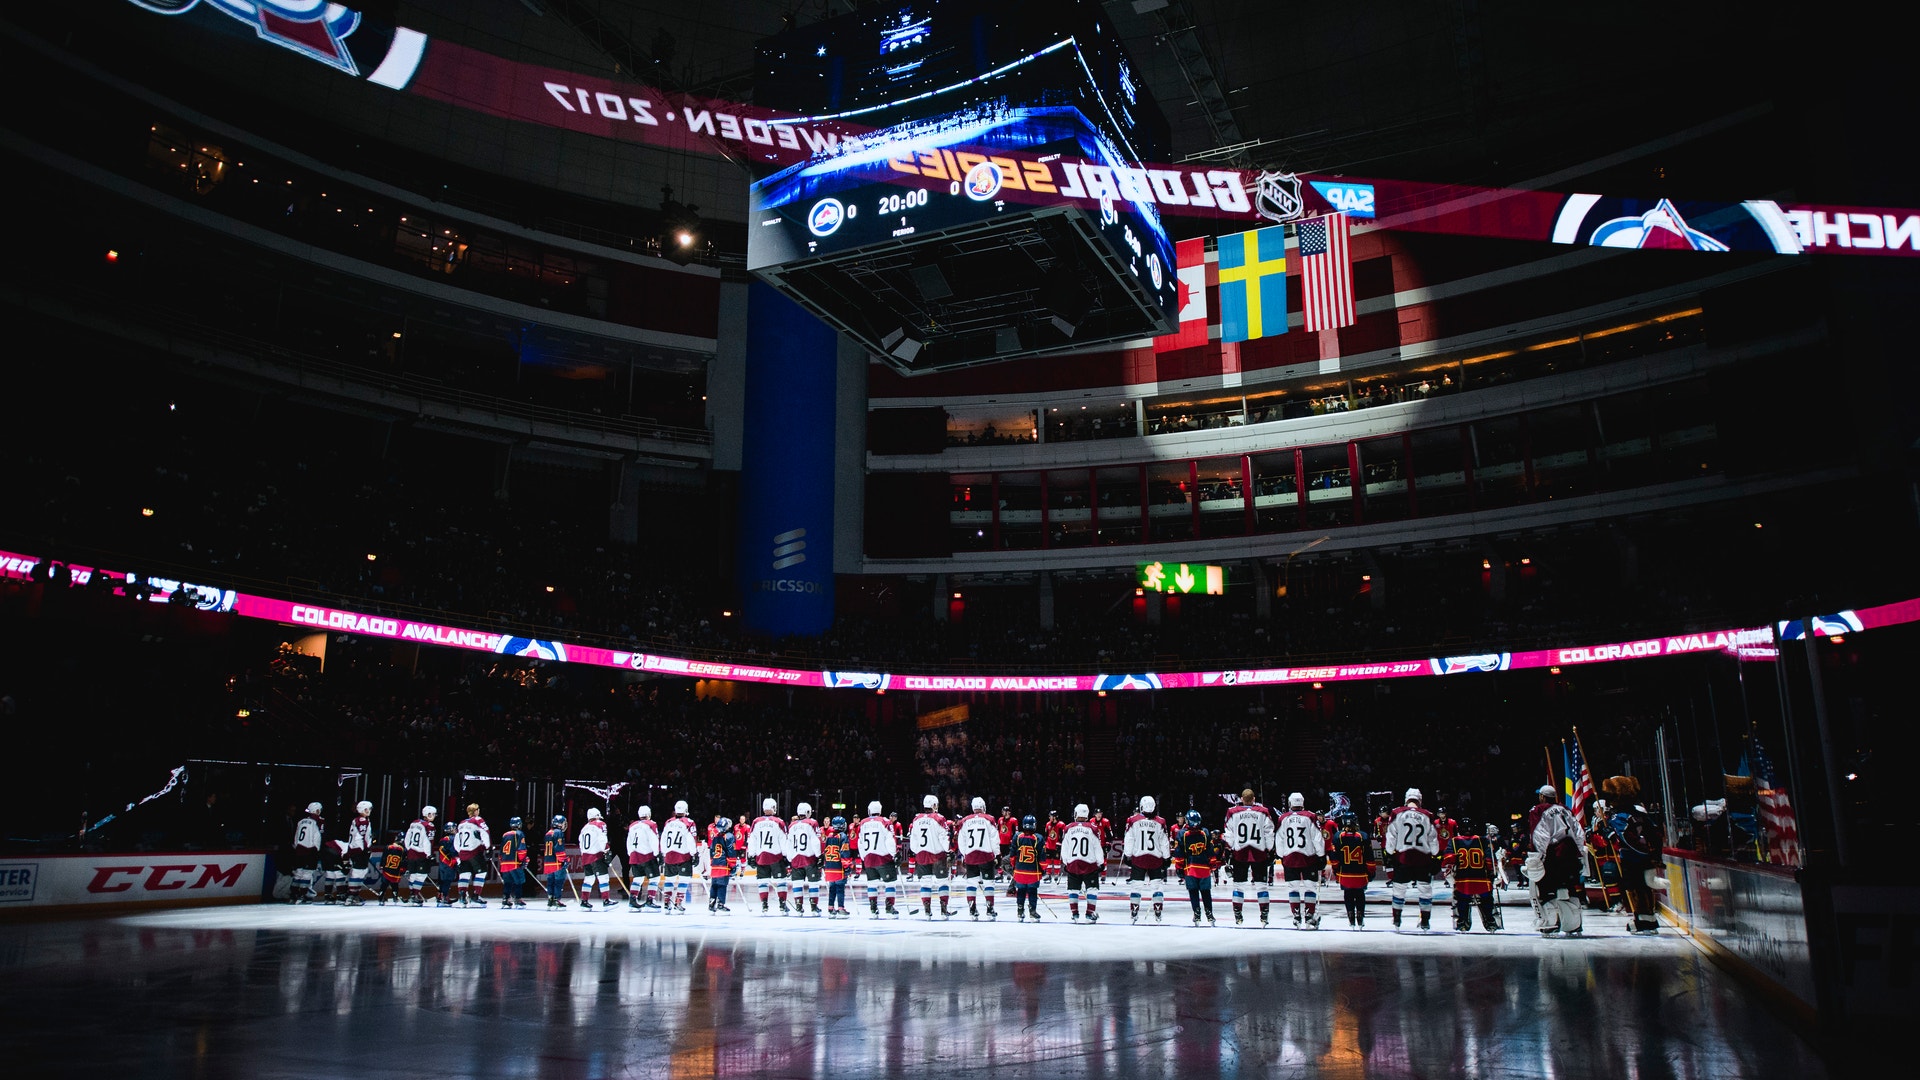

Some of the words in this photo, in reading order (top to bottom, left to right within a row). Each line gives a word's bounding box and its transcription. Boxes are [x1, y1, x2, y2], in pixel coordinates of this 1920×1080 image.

[847, 204, 857, 219] 0
[878, 188, 929, 216] 20:00
[900, 216, 907, 226] 1
[291, 605, 397, 636] COLORADO
[1559, 640, 1661, 663] COLORADO
[688, 662, 730, 676] SERIES
[777, 671, 802, 682] 2017
[1289, 668, 1337, 679] SERIES
[1393, 663, 1421, 673] 2017
[905, 677, 987, 689] COLORADO
[990, 677, 1077, 689] AVALANCHE
[298, 826, 307, 842] 6
[632, 832, 639, 849] 4
[666, 830, 682, 849] 64
[759, 830, 773, 849] 14
[863, 831, 880, 852] 57
[919, 828, 928, 848] 3
[967, 828, 986, 849] 37
[1140, 830, 1156, 851] 13
[1237, 822, 1262, 844] 94
[1286, 827, 1307, 849] 83
[1403, 822, 1425, 847] 22
[502, 840, 512, 855] 4
[824, 844, 841, 862] 25
[1017, 845, 1035, 864] 15
[1071, 836, 1089, 858] 20
[1340, 845, 1364, 865] 14
[1456, 847, 1485, 869] 30
[0, 868, 31, 886] TER
[86, 863, 248, 894] CCM
